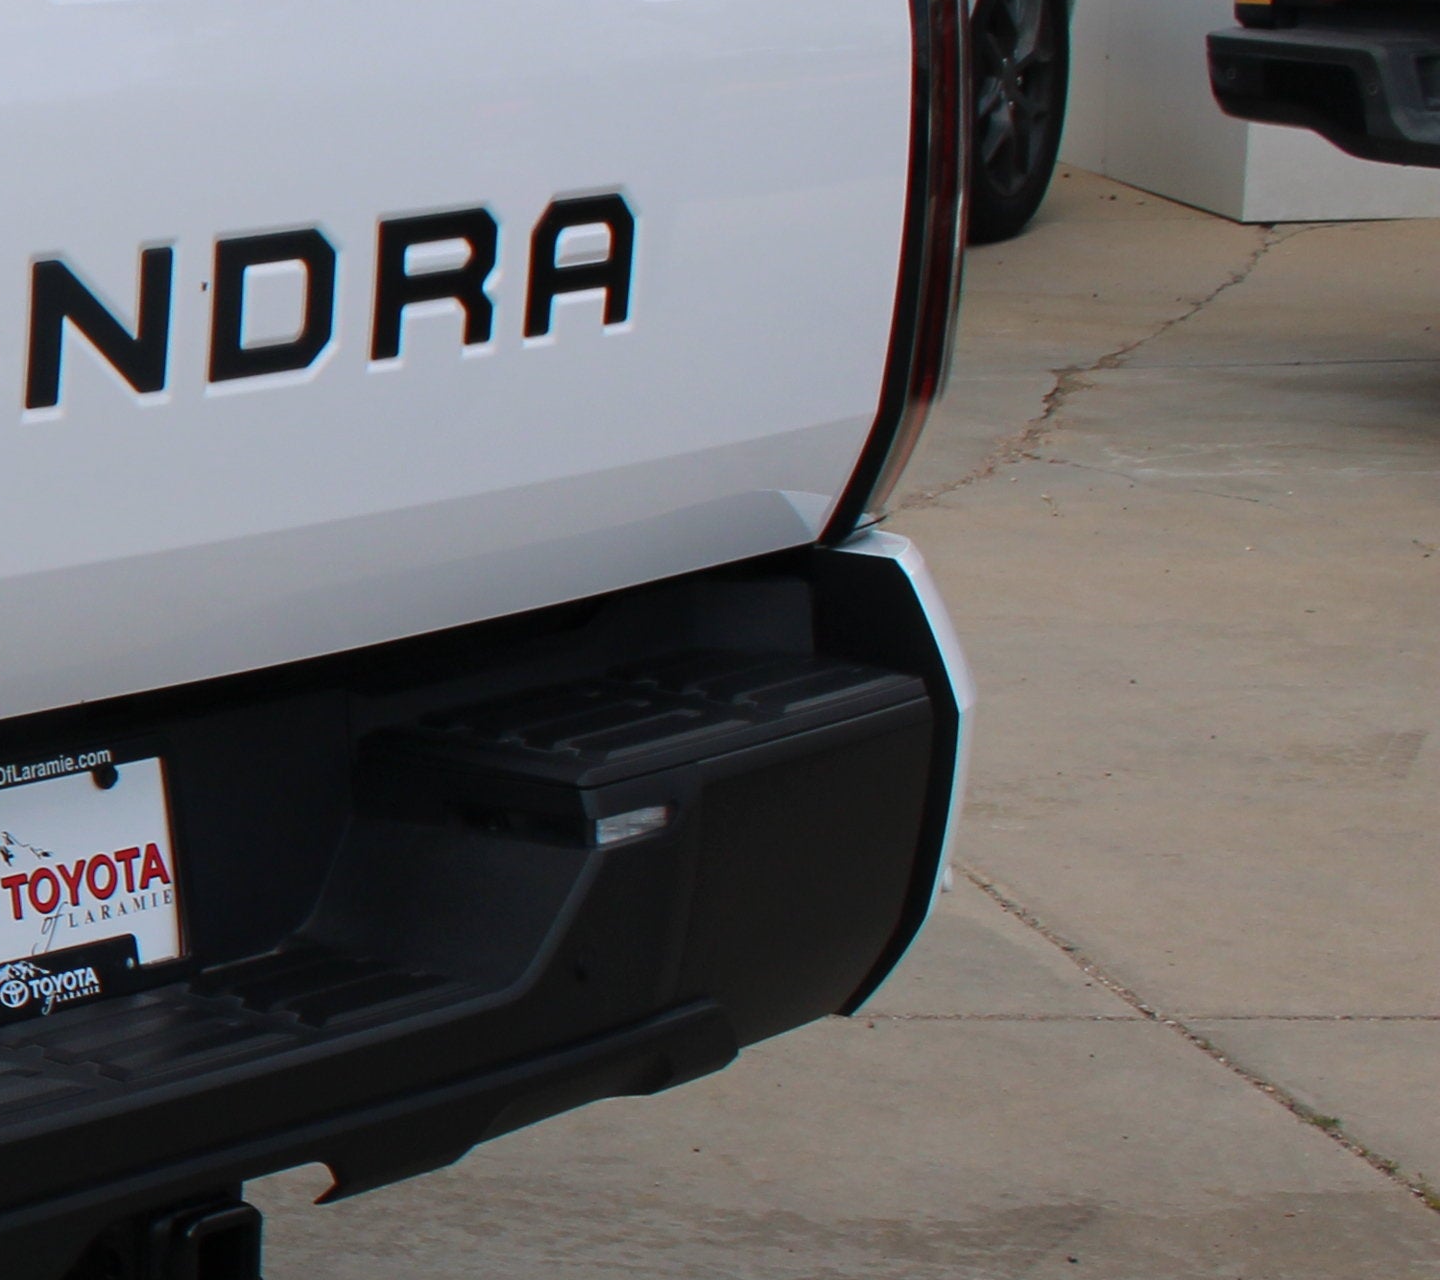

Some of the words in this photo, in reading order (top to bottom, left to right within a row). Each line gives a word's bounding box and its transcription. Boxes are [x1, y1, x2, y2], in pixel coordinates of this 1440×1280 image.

[0, 842, 171, 920] TOYOTA
[68, 889, 173, 929] LARAMIE
[29, 967, 99, 999] TOYOTA
[56, 984, 101, 1003] LARAMIE
